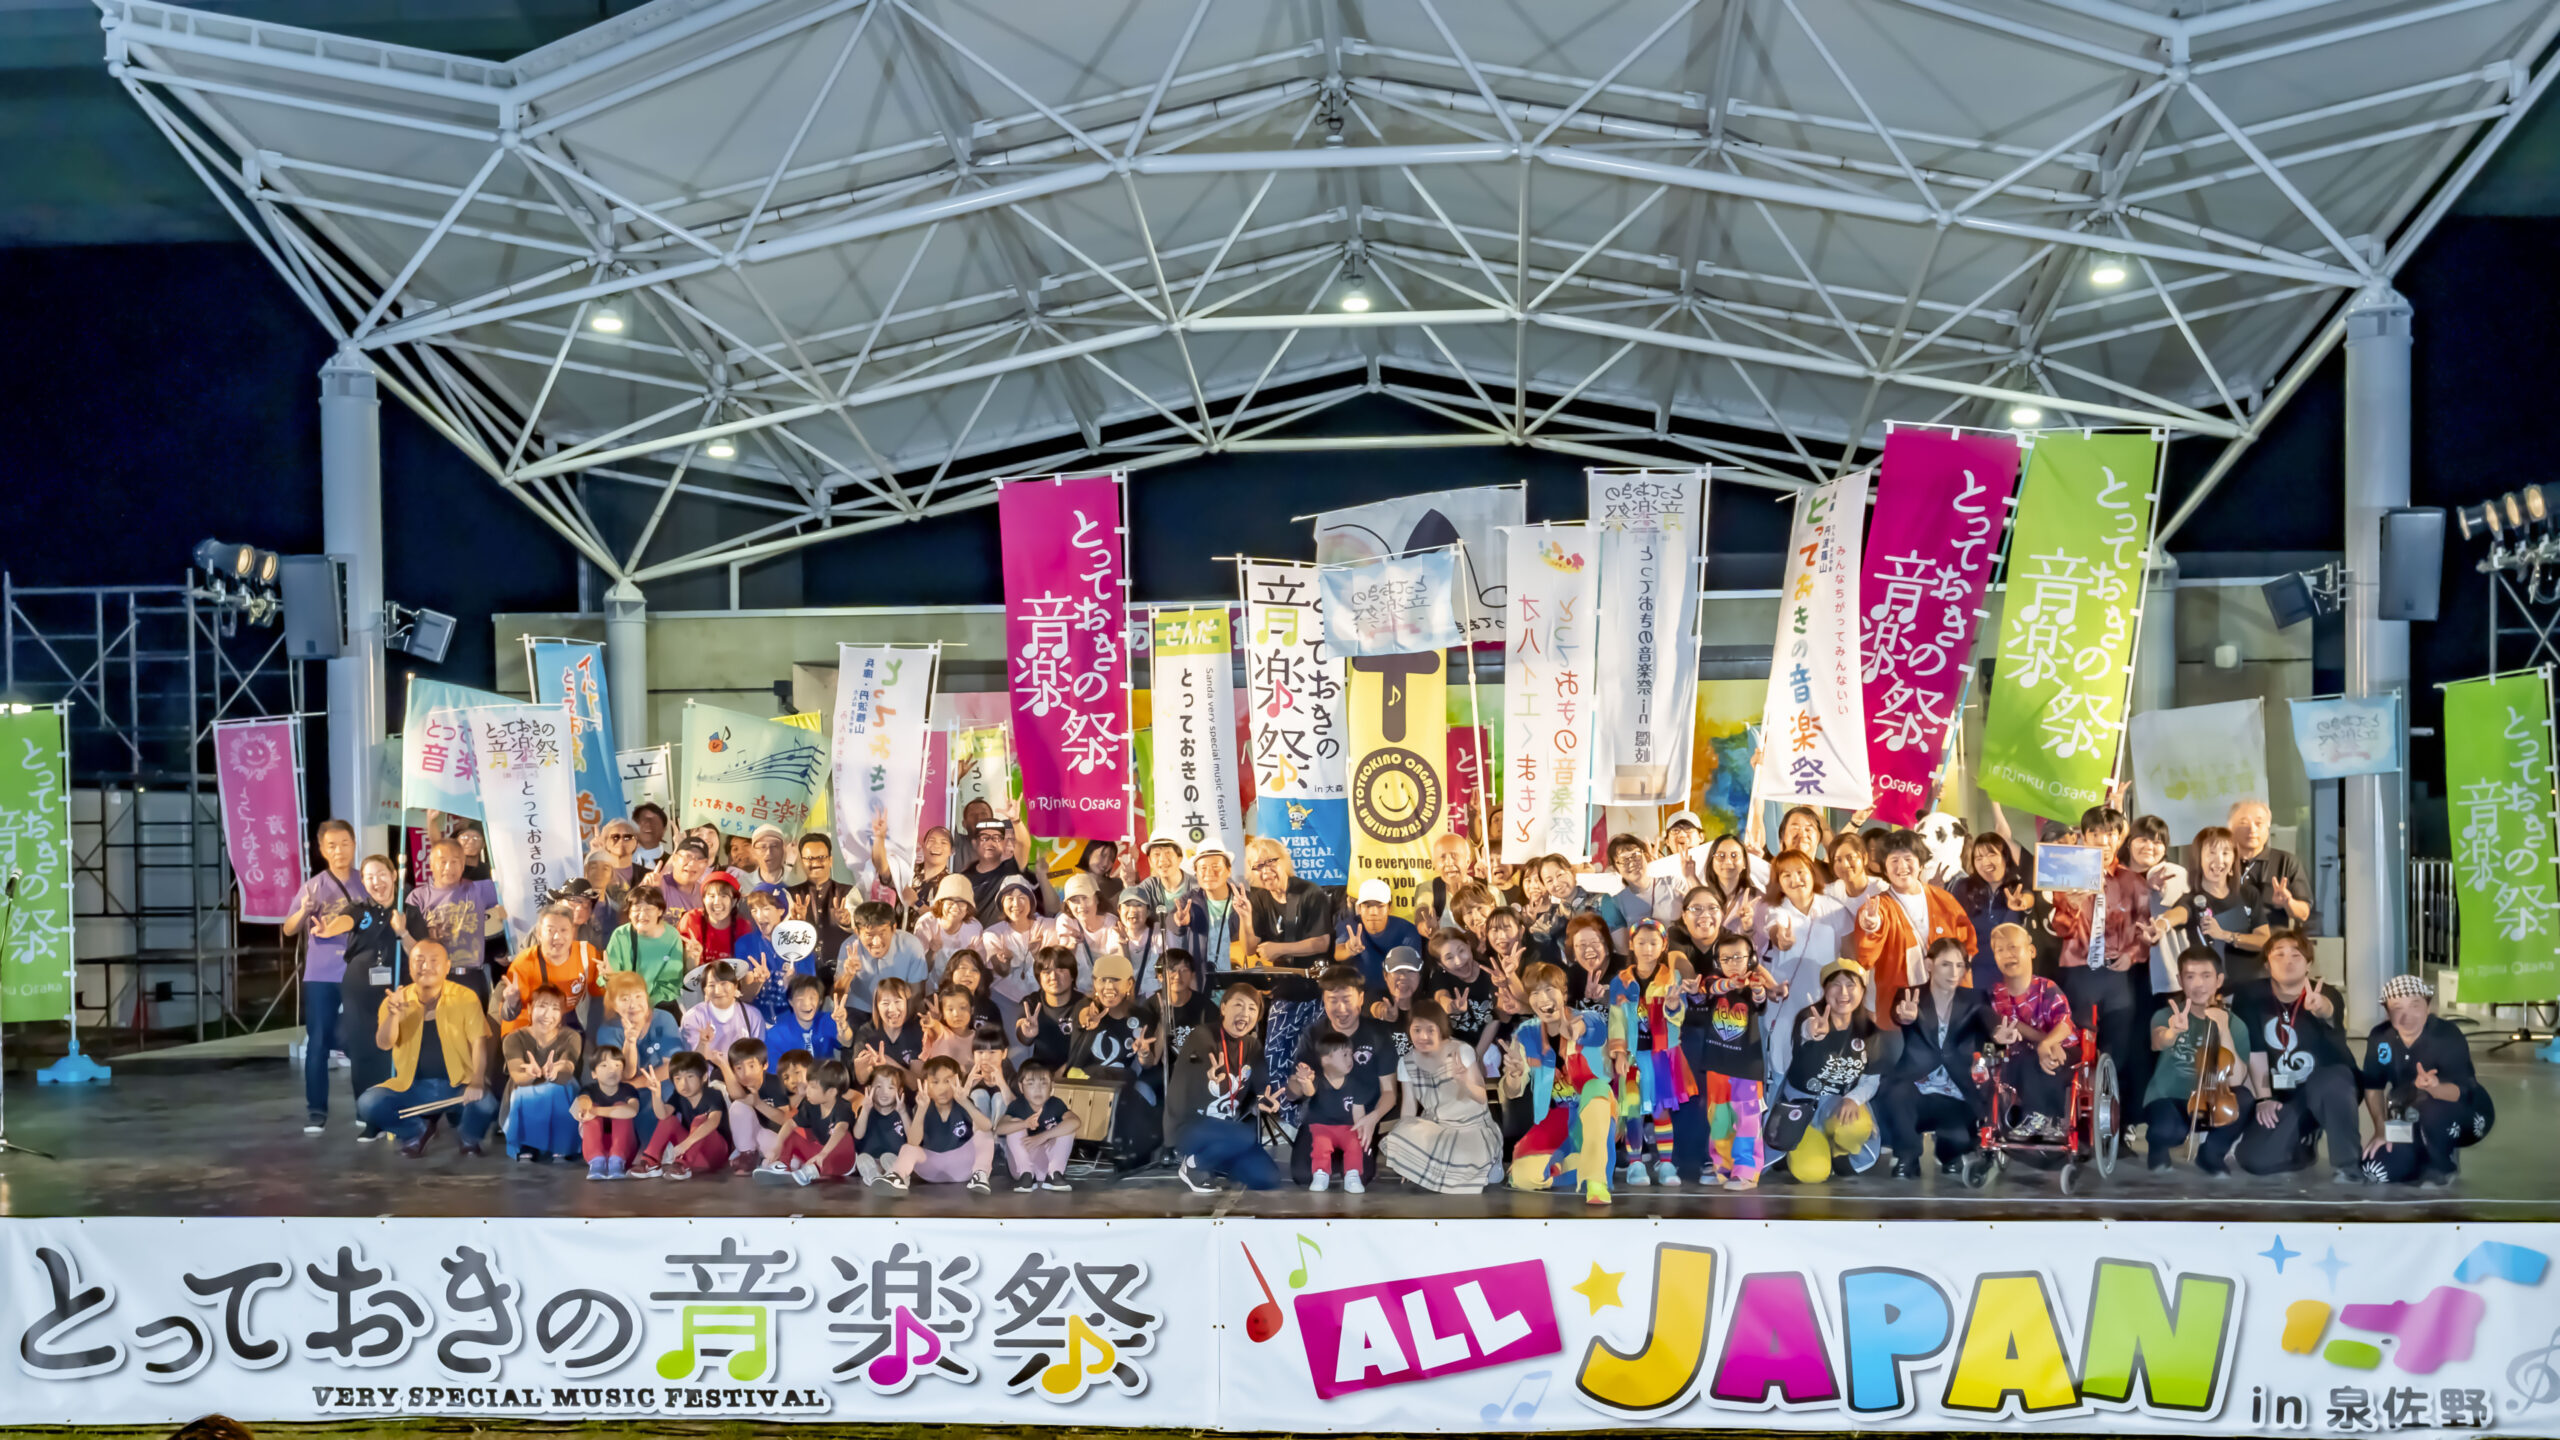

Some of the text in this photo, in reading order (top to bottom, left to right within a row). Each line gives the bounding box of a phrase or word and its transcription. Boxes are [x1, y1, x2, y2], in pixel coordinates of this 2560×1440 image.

[1072, 510, 1118, 703] とっておきの
[1908, 470, 1990, 676] とっておきの
[2074, 466, 2137, 680] とっておきの
[1165, 619, 1217, 646] さんだ
[1789, 495, 1828, 795] とっておきの音楽祭
[1834, 545, 1849, 716] みんなちがってみんないい
[1861, 550, 1956, 753] 音楽祭
[2005, 548, 2122, 759] 音楽祭
[1015, 591, 1121, 775] 音楽祭
[1253, 575, 1311, 792] 音楽祭
[1304, 598, 1340, 760] ておきの
[486, 717, 555, 738] とっておきの
[486, 733, 560, 769] 音楽祭
[1205, 667, 1228, 831] Sanda very special music festival
[19, 738, 59, 900] とっておきの
[1027, 796, 1121, 812] in Rinku Osaka
[1314, 784, 1344, 793] in 大森
[1356, 753, 1437, 838] TOTEOKINO ONGAKUSAI FUKUSHIMA
[1879, 774, 1924, 797] Osaka
[2001, 768, 2044, 791] Rinku
[2048, 781, 2098, 802] Osaka
[2503, 706, 2546, 876] とっておきの
[1280, 836, 1319, 847] VERY
[1287, 848, 1335, 858] PECIAL
[1293, 858, 1325, 868] USIC
[1299, 869, 1342, 880] TIVAL
[1358, 855, 1435, 871] To everyone,
[1391, 877, 1415, 889] you
[2457, 778, 2551, 942] 音楽祭
[1396, 896, 1408, 908] to
[20, 1237, 1154, 1397] とっておきの音楽祭
[1333, 1241, 2236, 1413] ALL JAPAN
[312, 1386, 825, 1408] VERY SPECIAL MUSIC FESTIVAL
[2251, 1387, 2490, 1429] in 泉佐野
